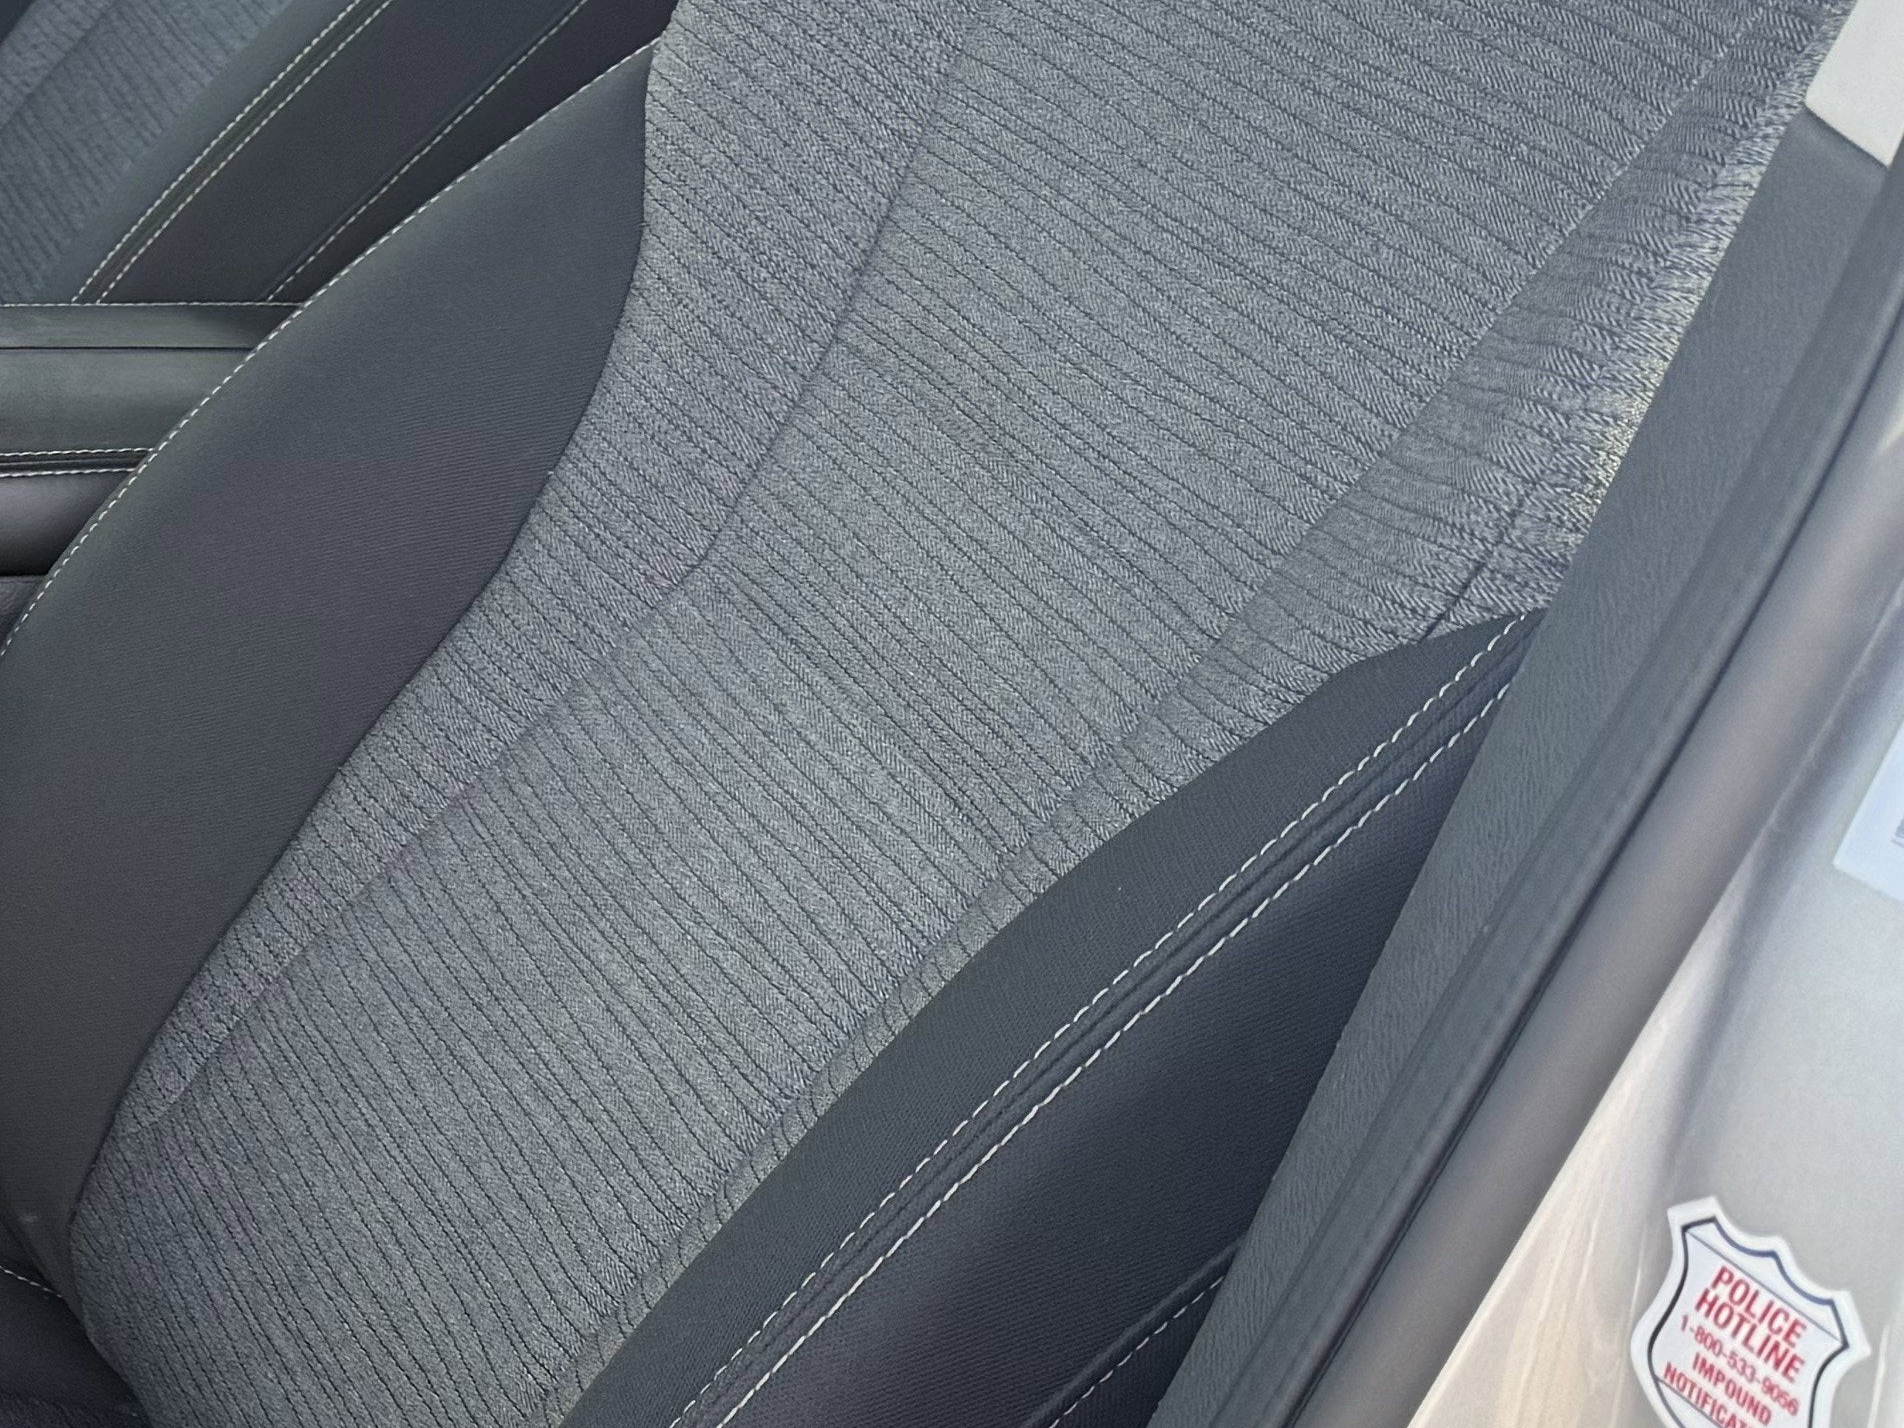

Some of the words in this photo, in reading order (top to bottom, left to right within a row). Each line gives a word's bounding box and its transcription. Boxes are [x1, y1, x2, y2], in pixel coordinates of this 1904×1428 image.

[1695, 1287, 1806, 1384] HOTLINE
[1710, 1265, 1807, 1348] POLICE
[1680, 1313, 1800, 1417] 1-800-533-9056
[1693, 1352, 1773, 1427] IMPOUND
